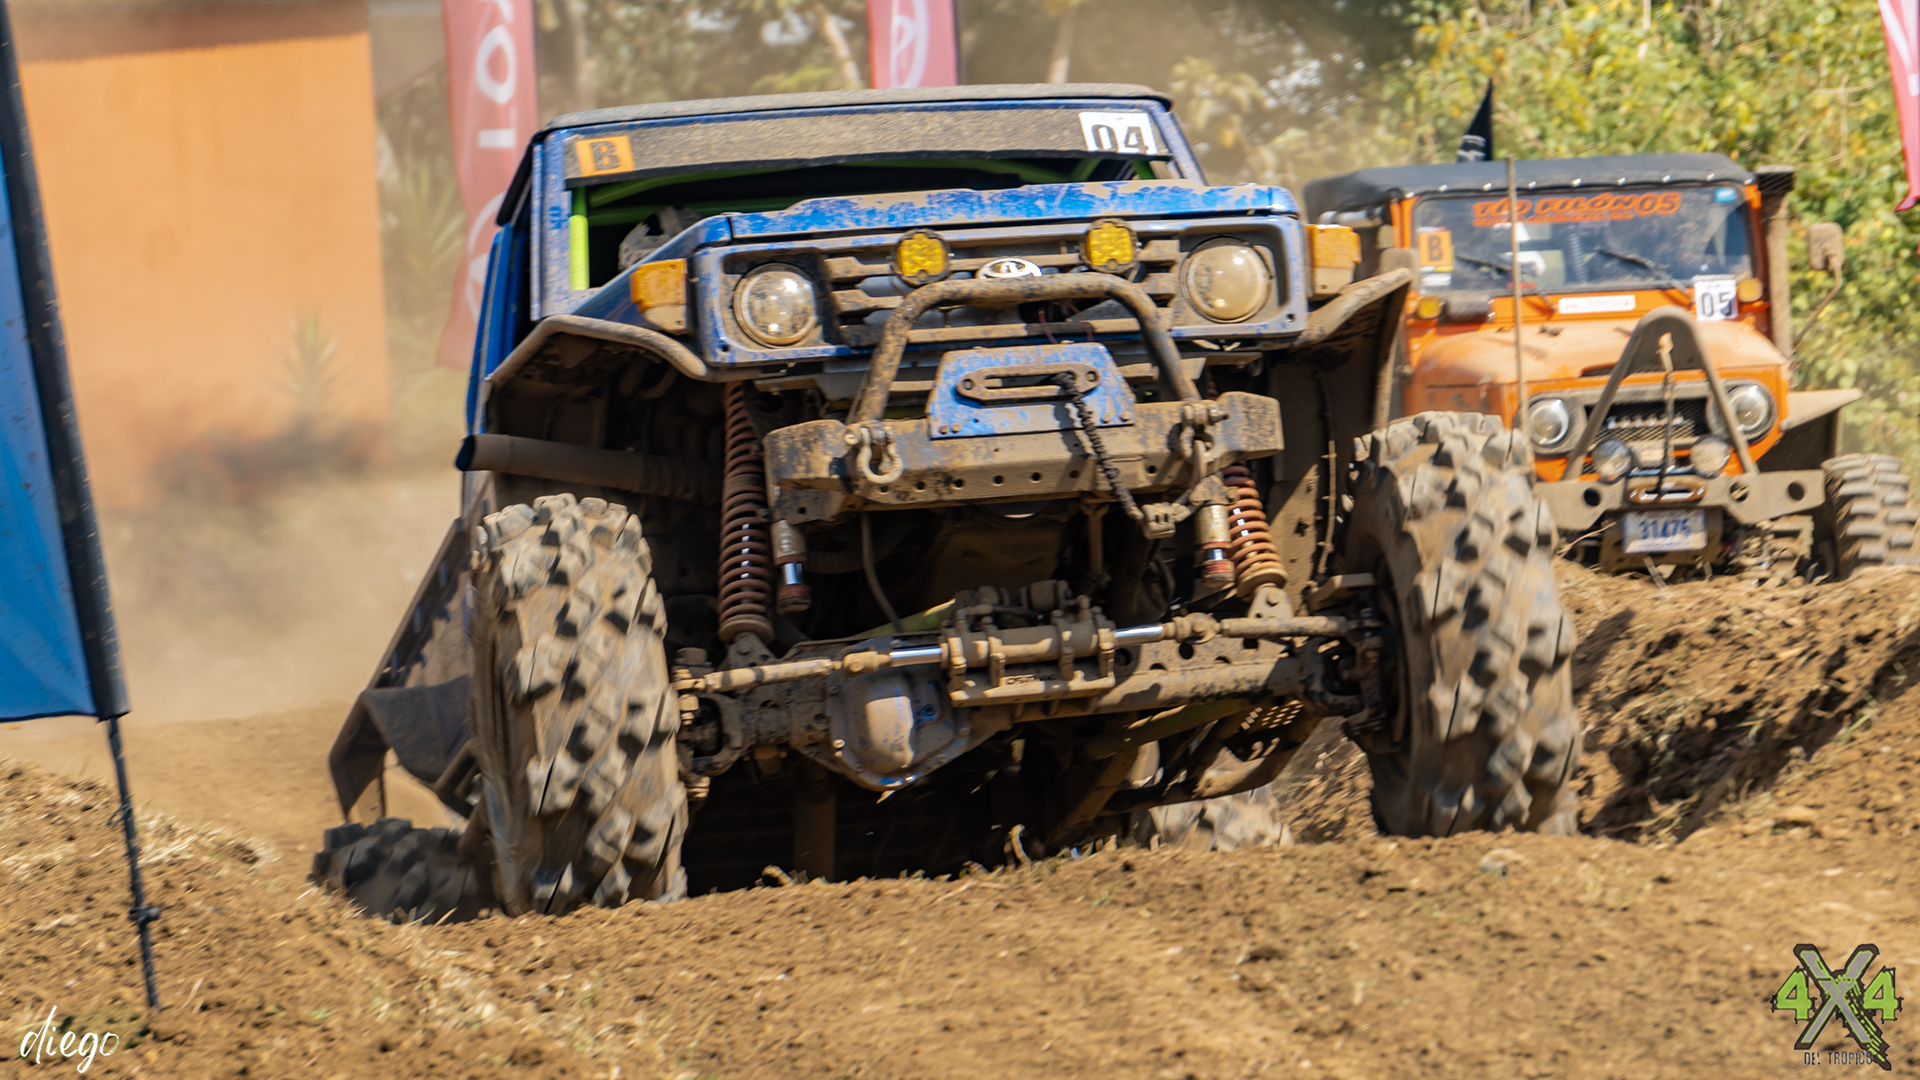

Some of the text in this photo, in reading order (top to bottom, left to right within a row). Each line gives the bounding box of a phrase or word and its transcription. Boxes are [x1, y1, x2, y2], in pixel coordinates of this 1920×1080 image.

[1091, 125, 1149, 154] 04
[590, 141, 620, 170] B
[1428, 235, 1442, 261] B
[1701, 292, 1732, 317] 05
